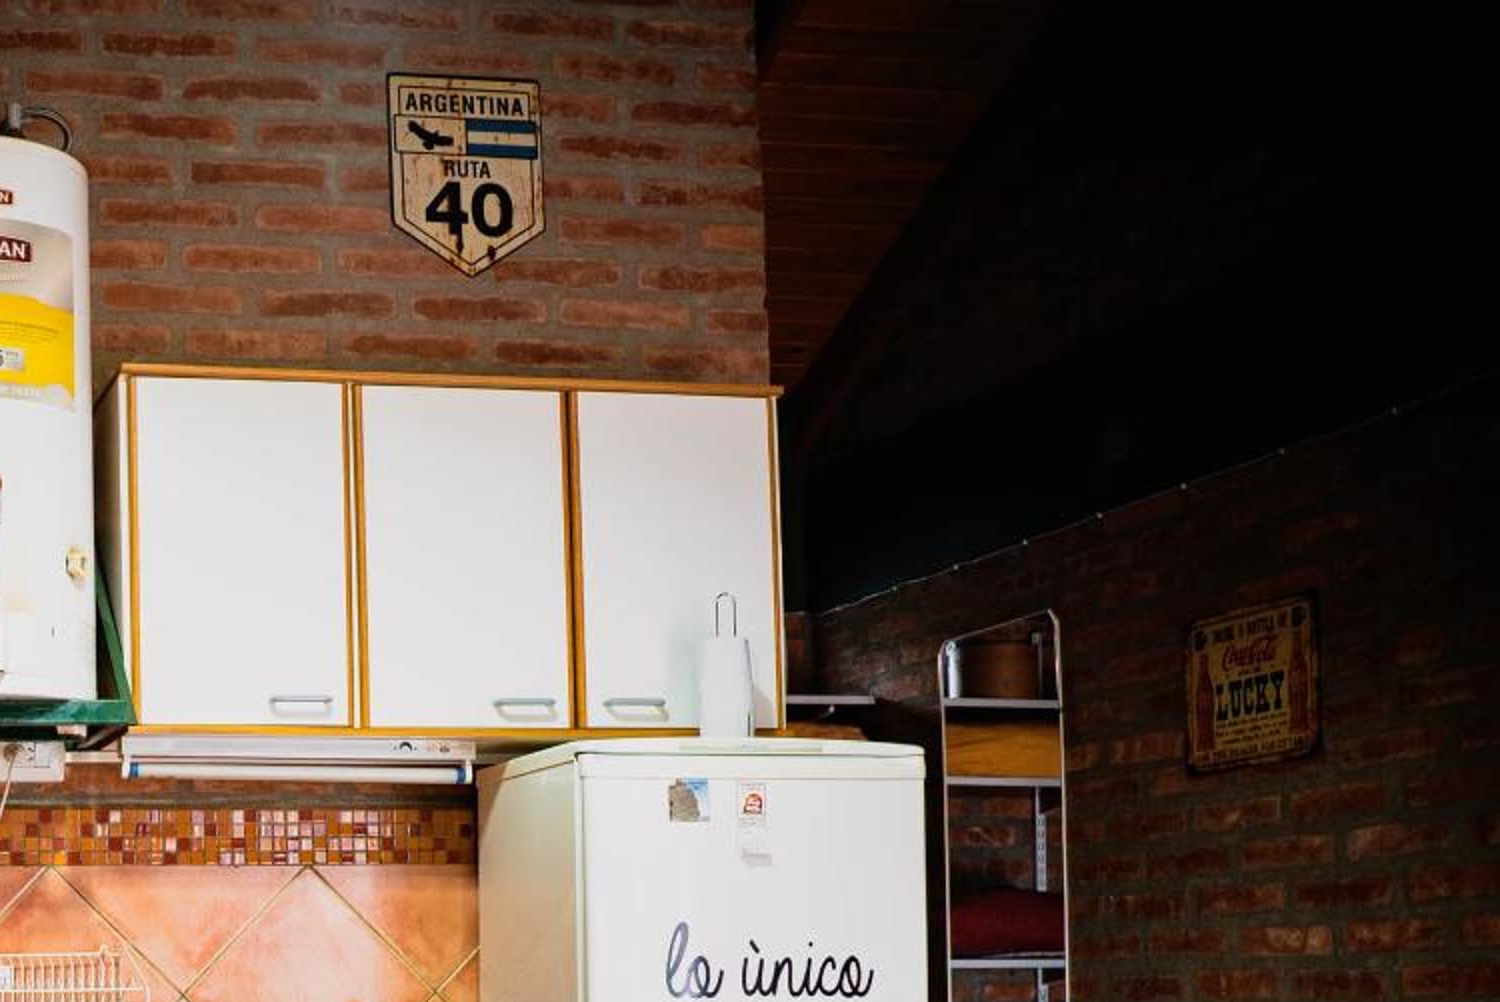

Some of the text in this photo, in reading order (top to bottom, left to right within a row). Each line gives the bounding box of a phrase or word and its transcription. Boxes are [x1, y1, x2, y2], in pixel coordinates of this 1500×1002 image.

[405, 92, 524, 117] ARGENTINA
[443, 159, 492, 179] RUTA
[425, 181, 514, 238] 40
[1215, 671, 1286, 721] LUCKY
[665, 921, 724, 1000] lo
